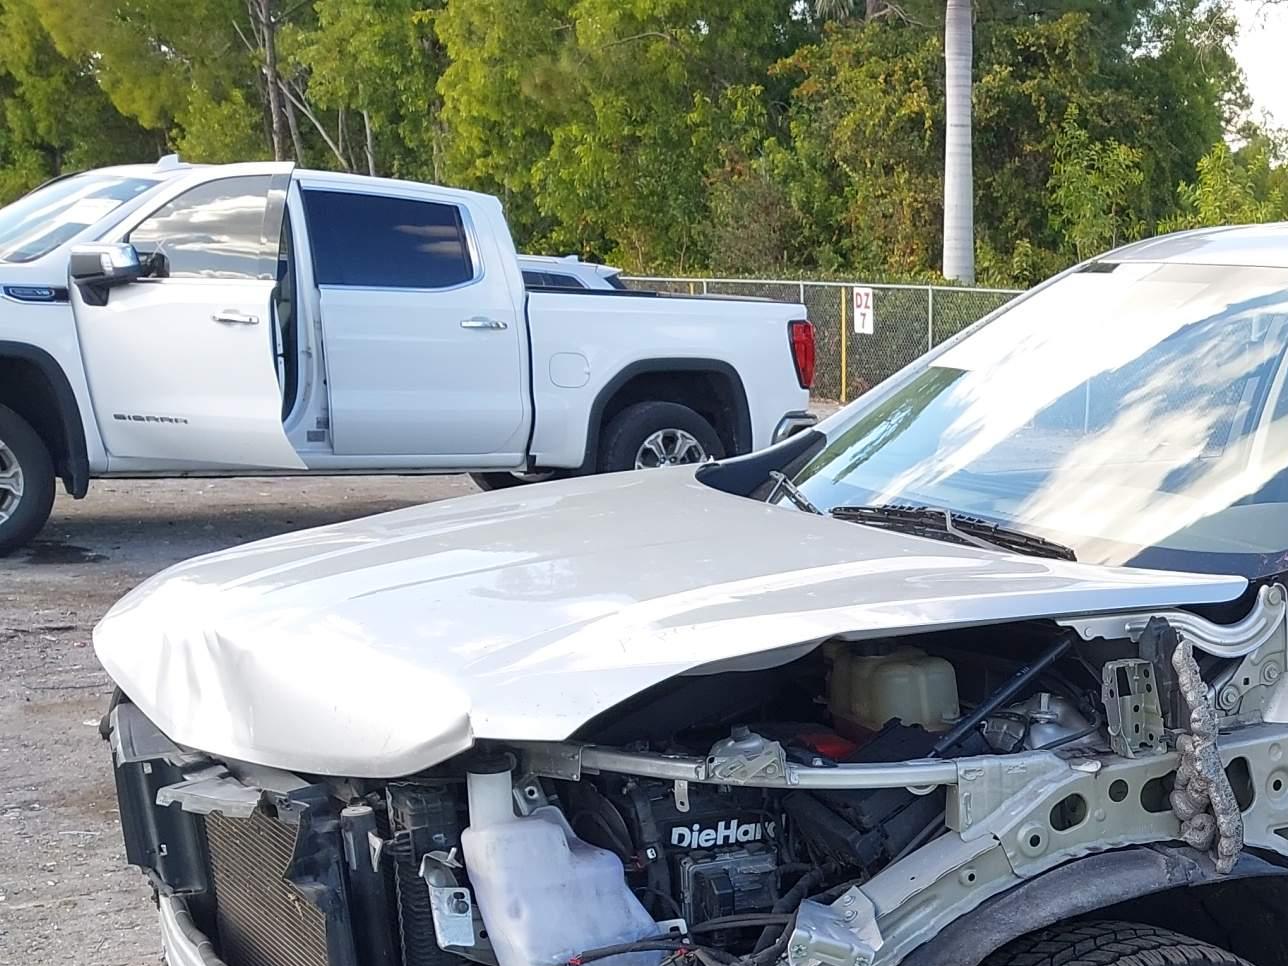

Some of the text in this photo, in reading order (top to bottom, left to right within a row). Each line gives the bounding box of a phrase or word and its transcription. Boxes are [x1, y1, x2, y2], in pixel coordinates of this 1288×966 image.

[855, 292, 871, 309] DZ
[860, 312, 867, 329] 7
[113, 413, 188, 425] SIERRA
